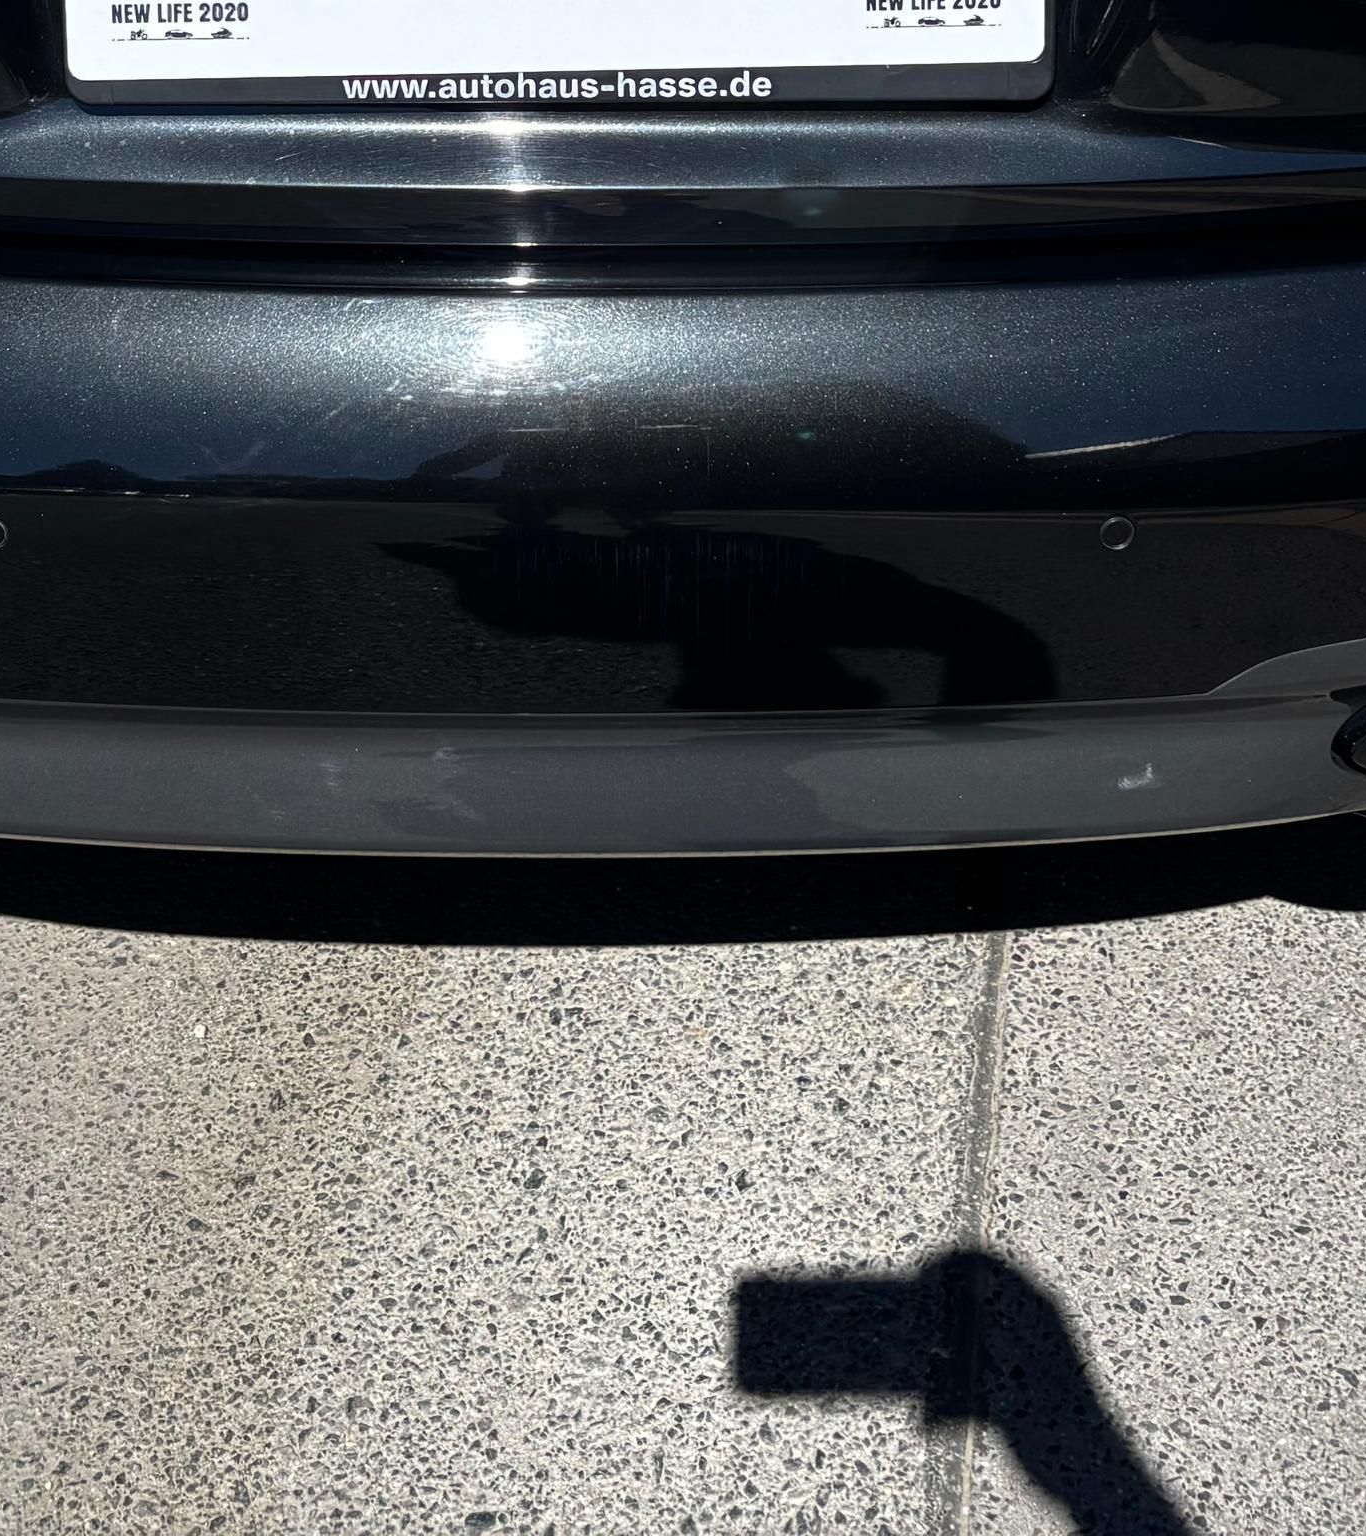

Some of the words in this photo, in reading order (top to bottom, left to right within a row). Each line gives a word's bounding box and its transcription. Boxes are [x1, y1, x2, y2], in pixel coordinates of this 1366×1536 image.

[111, 4, 151, 25] NEW
[157, 3, 193, 24] LIFE
[198, 1, 249, 23] 2020
[342, 70, 773, 101] www.autohaus-hasse.de
